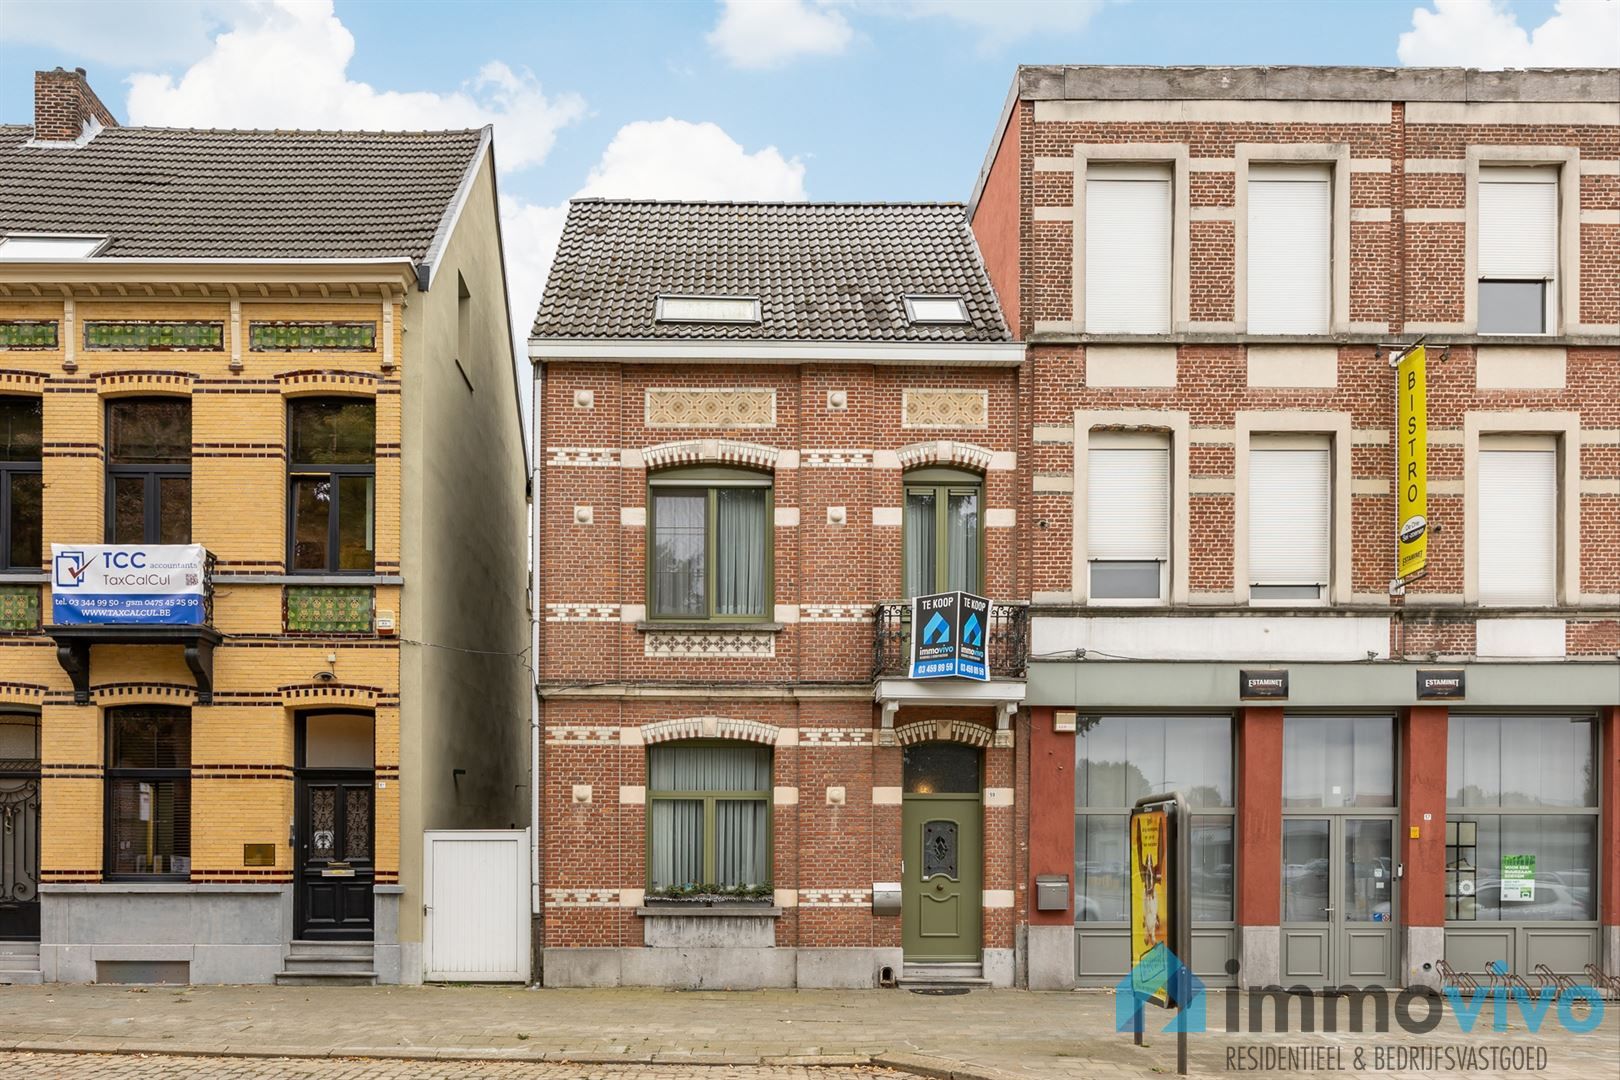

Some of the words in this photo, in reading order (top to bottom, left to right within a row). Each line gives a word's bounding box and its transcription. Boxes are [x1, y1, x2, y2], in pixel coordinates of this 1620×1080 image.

[1407, 371, 1418, 503] BISTRO
[103, 552, 146, 569] TCC
[103, 574, 171, 586] TaxCalCul
[55, 598, 67, 606] tel.
[922, 599, 932, 610] TE
[932, 596, 954, 609] KOOP
[963, 597, 971, 608] TE
[971, 599, 986, 612] KOOP
[81, 609, 171, 617] WWW.TAXCALCUL.BE
[919, 644, 954, 656] immovivo
[960, 643, 984, 658] immovivo
[1248, 679, 1283, 688] ESTAMINET
[1425, 679, 1460, 688] ESTAMINET
